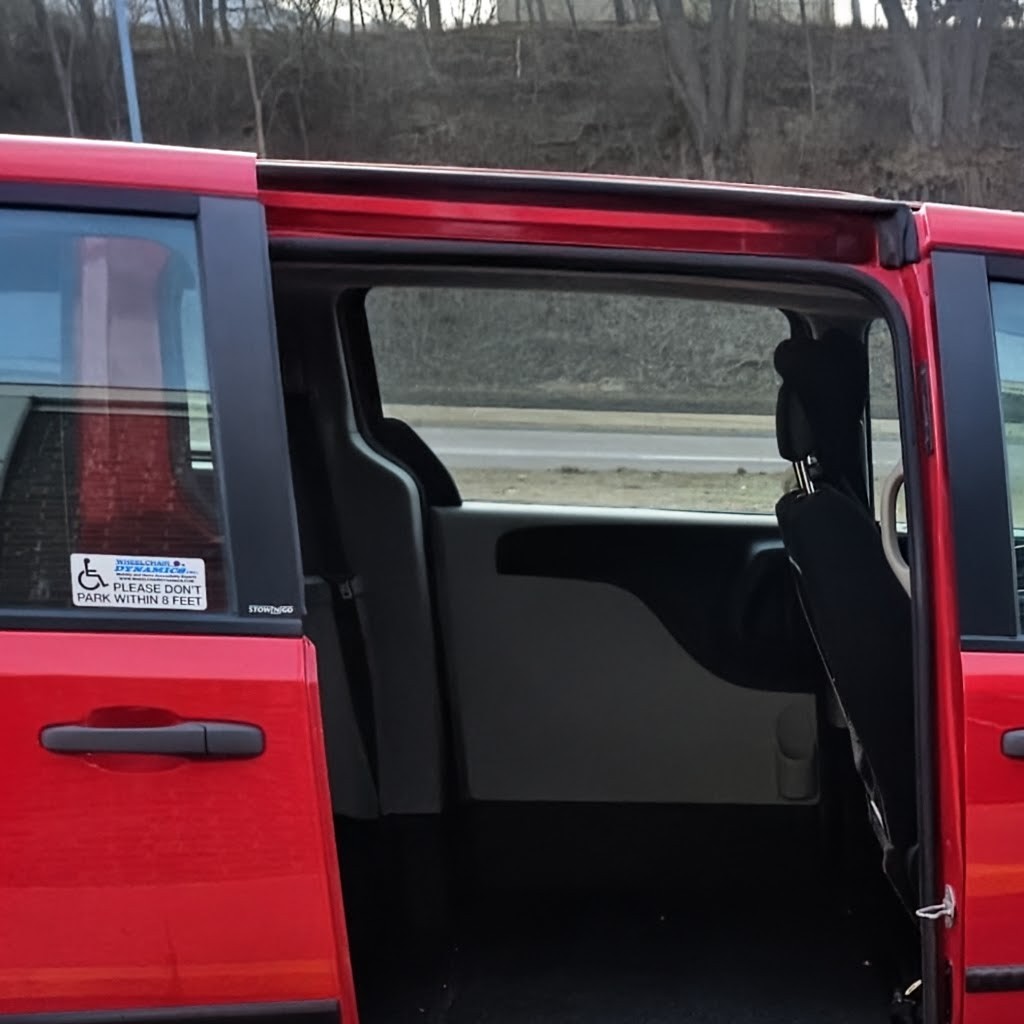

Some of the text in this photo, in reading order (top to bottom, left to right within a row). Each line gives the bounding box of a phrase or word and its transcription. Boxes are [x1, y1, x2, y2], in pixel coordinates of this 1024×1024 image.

[116, 559, 170, 567] WHEELCHAIR
[114, 565, 186, 574] DYNAMICS
[113, 582, 202, 595] PLEASE DON'T
[77, 593, 202, 606] PARK WITHIN 8 FEET
